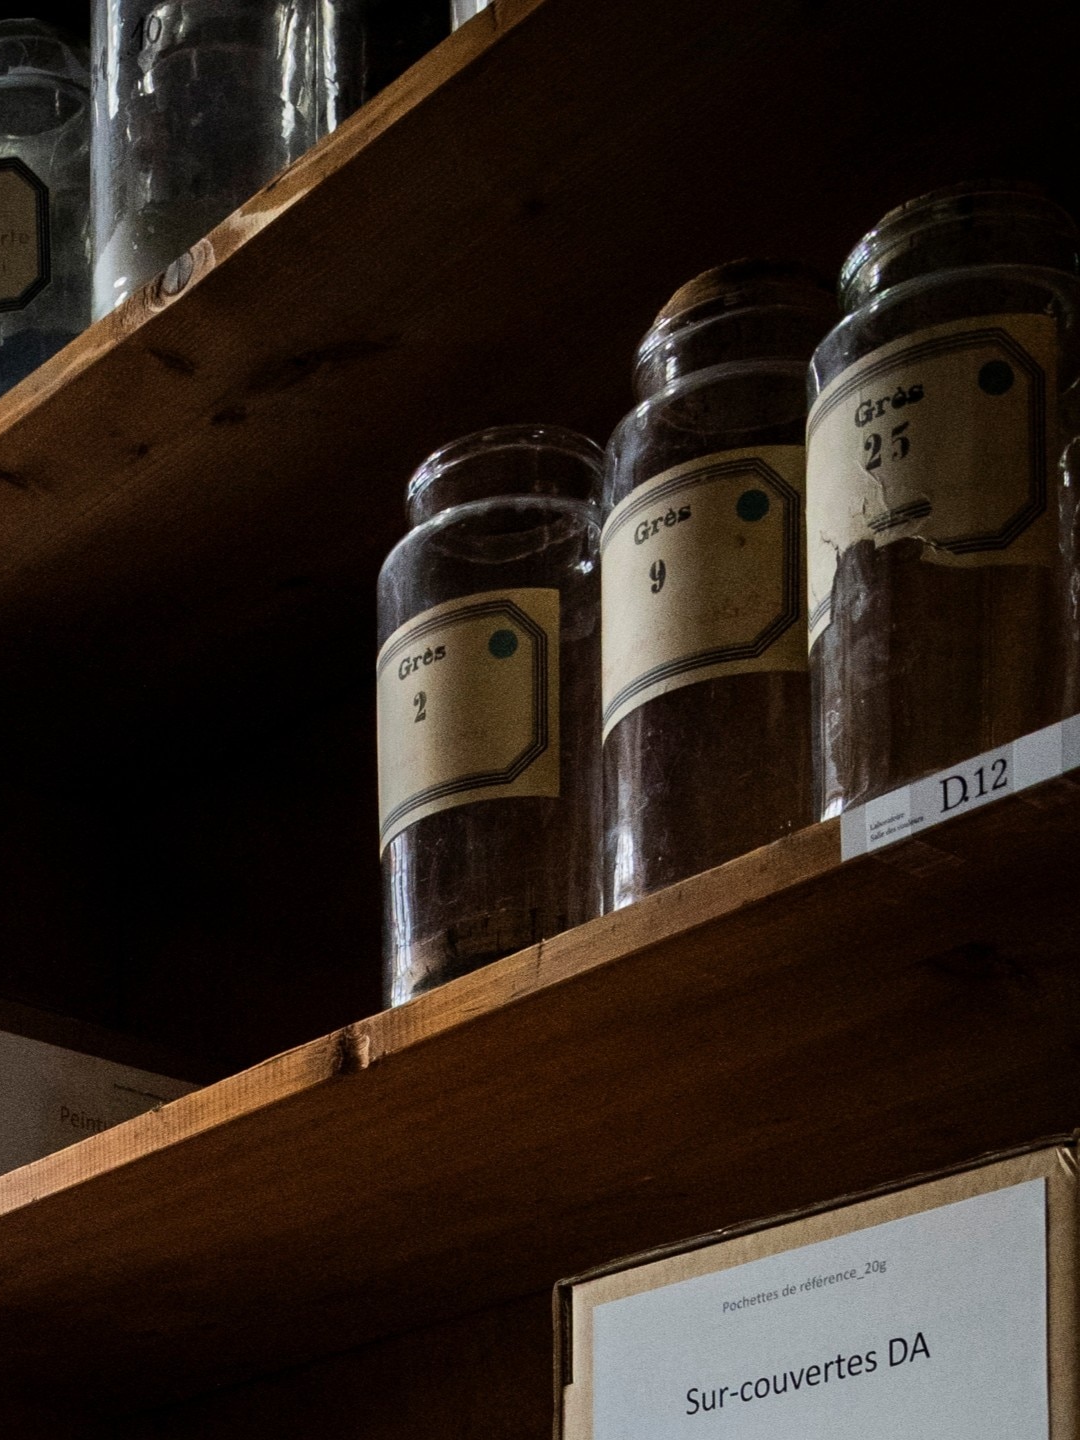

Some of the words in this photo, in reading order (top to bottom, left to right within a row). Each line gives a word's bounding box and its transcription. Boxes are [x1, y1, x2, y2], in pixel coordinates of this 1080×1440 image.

[853, 379, 926, 428] Grès
[863, 421, 912, 470] 25
[633, 502, 692, 547] Grès
[648, 558, 667, 595] 9
[397, 642, 446, 681] Grès
[413, 690, 428, 724] 2
[722, 1287, 779, 1314] Pochettes
[782, 1282, 797, 1298] de
[799, 1258, 888, 1294] référence_20g
[685, 1349, 878, 1416] Sur-couvertes
[887, 1332, 931, 1368] DA
